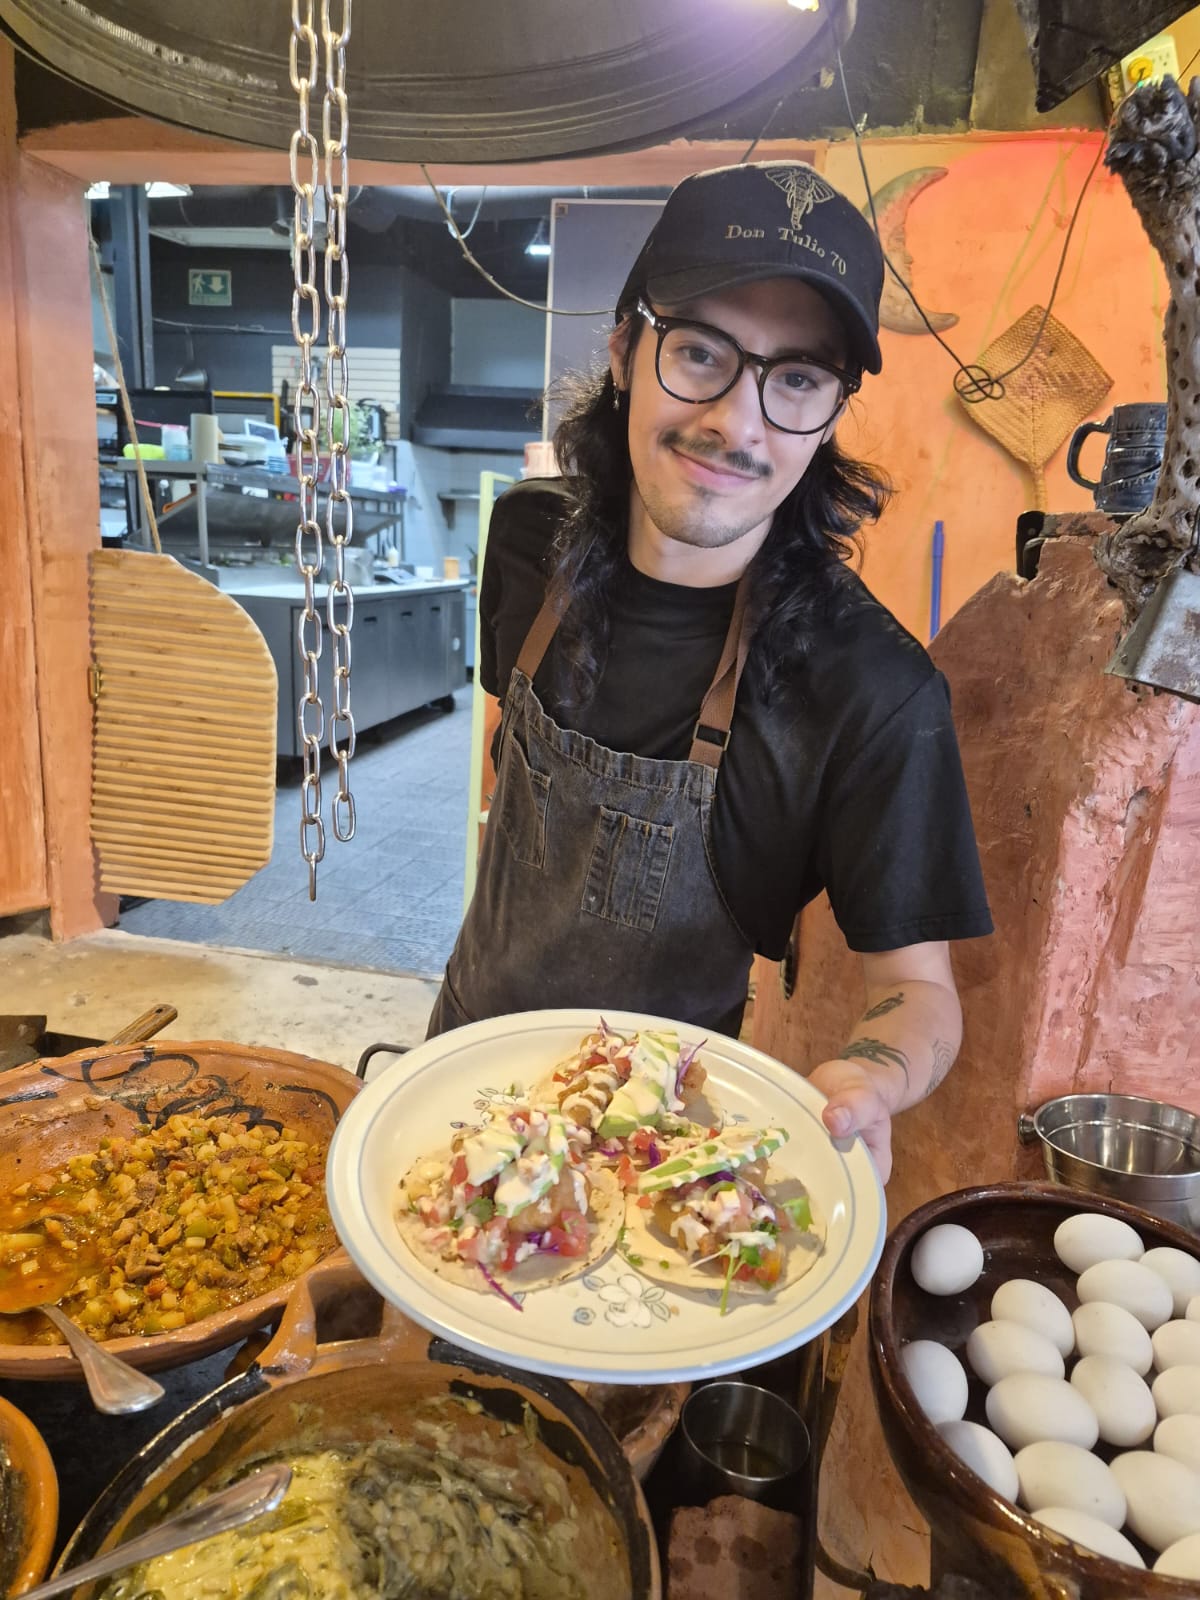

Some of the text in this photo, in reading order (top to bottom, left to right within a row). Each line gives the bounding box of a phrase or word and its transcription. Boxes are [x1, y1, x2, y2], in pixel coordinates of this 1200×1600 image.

[725, 225, 847, 275] Don Tulio 70
